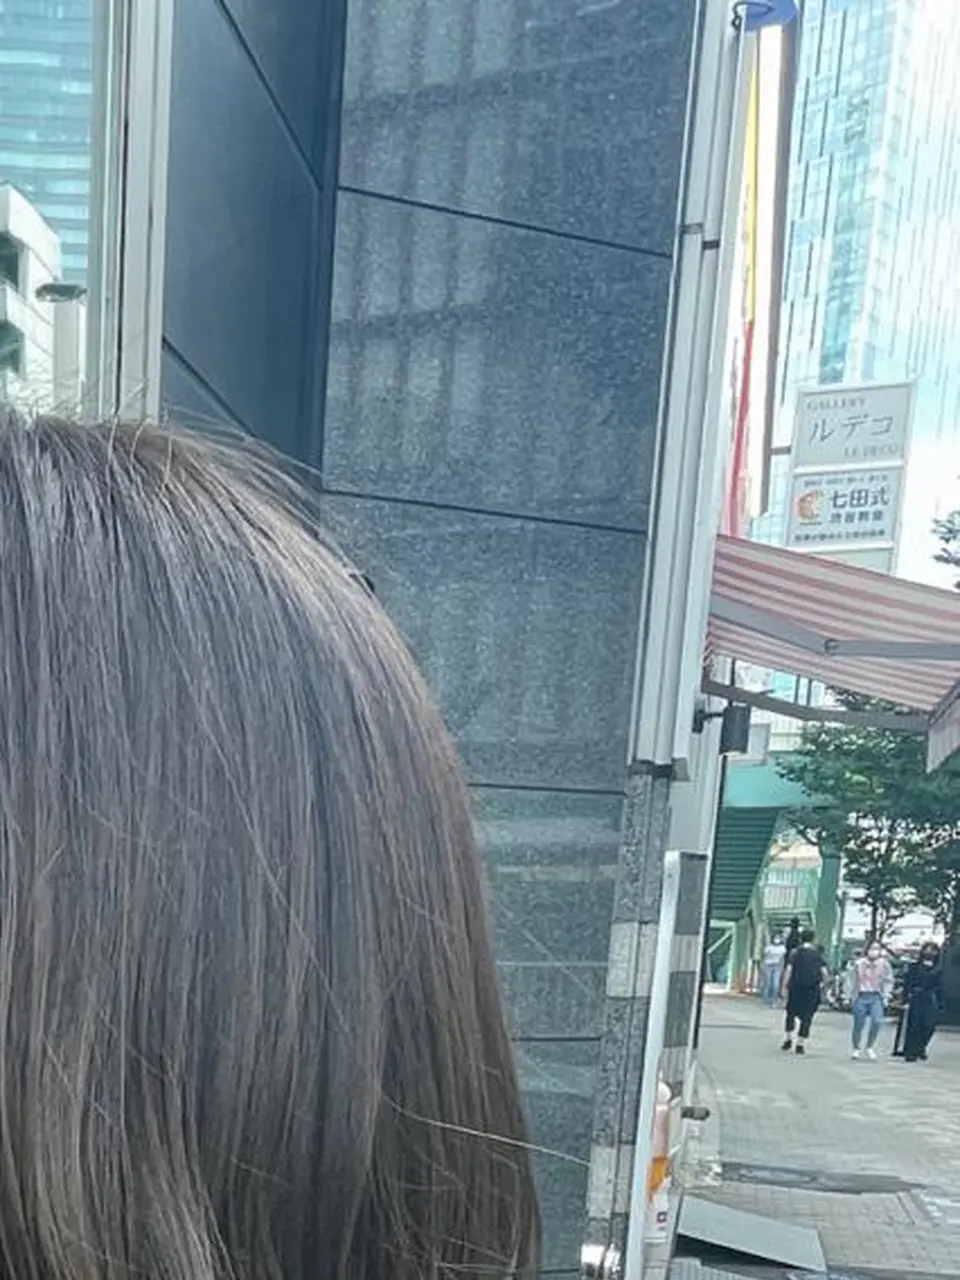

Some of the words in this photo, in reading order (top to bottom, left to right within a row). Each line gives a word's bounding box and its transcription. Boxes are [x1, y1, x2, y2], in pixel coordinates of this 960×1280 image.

[808, 414, 894, 443] ルデコ
[829, 486, 890, 509] 七田式
